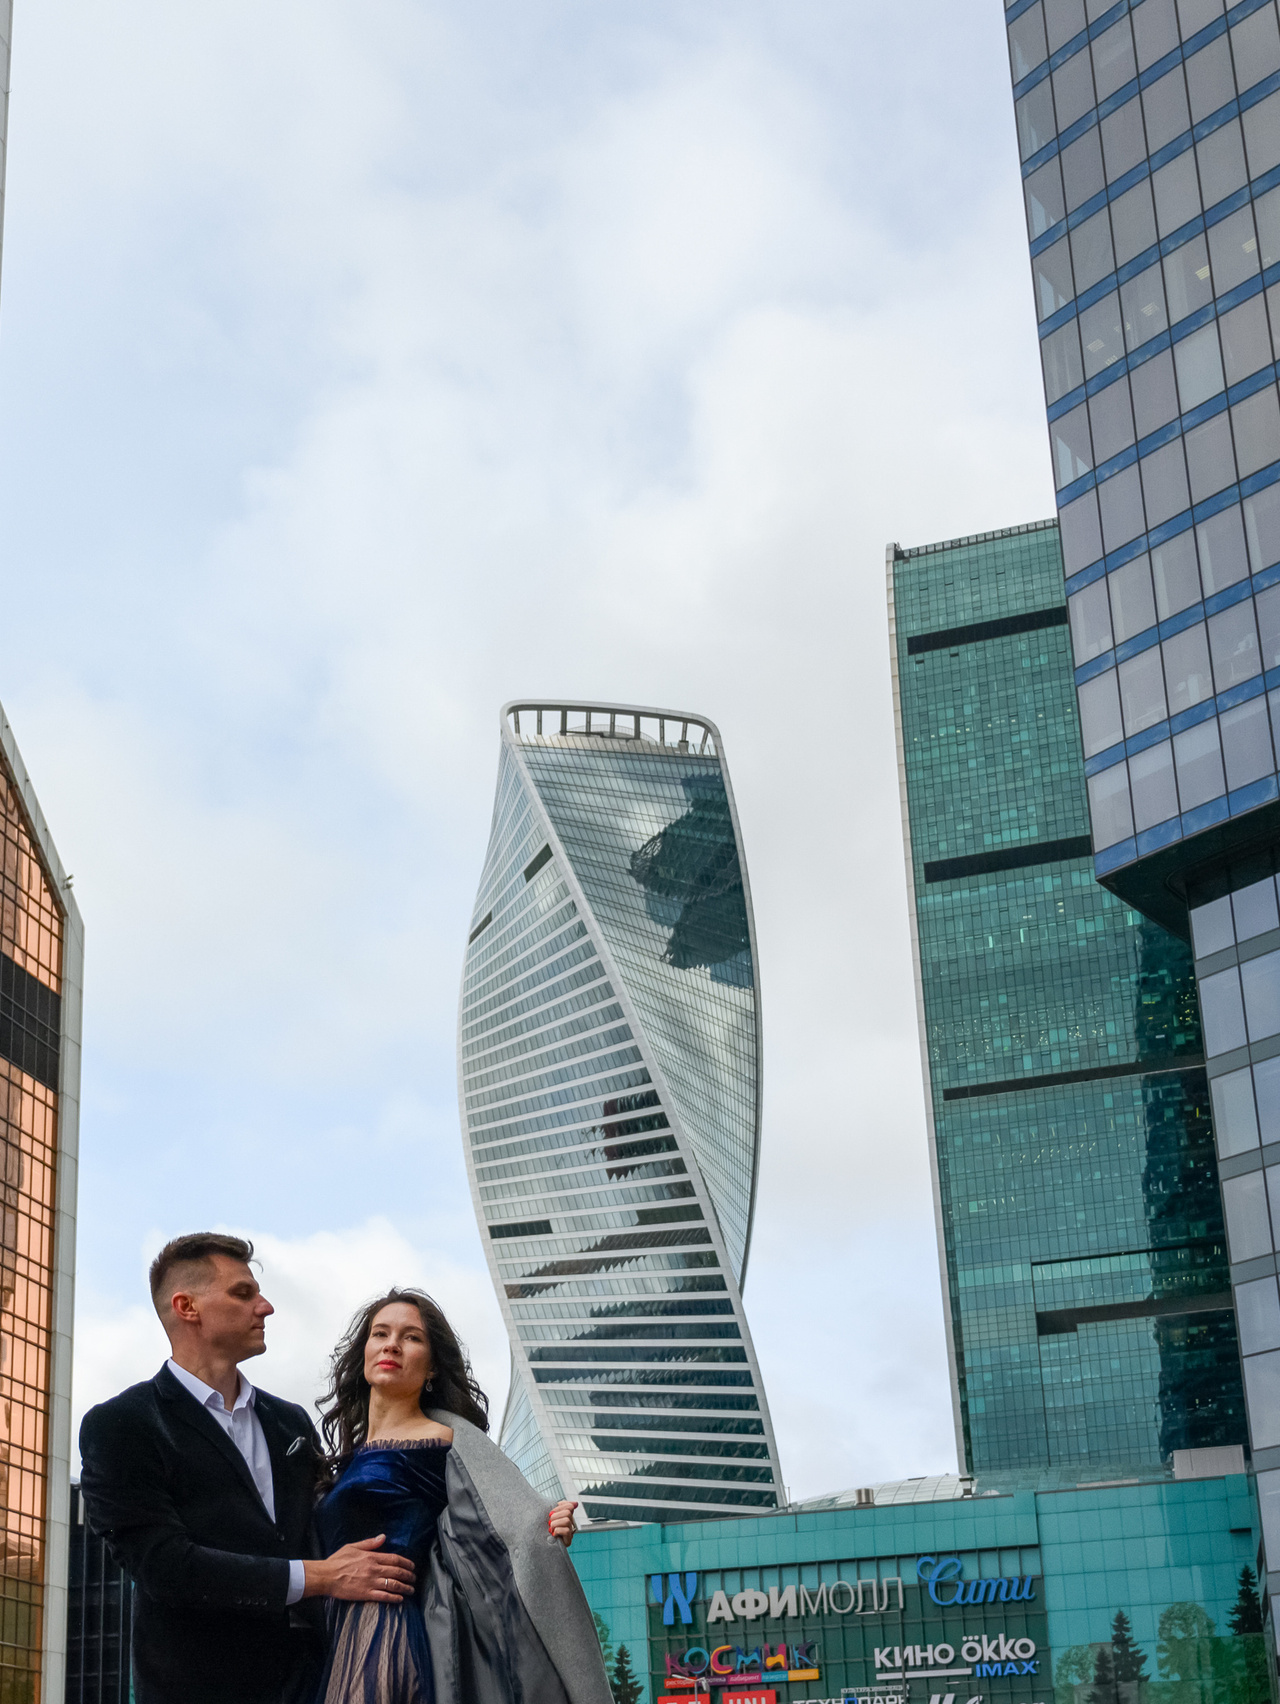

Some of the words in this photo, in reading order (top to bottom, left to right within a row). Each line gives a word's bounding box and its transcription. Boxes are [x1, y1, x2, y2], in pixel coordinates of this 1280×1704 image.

[707, 1576, 904, 1623] АФИМОЛЛ
[874, 1643, 955, 1668] КИНО
[975, 1660, 1037, 1678] IMAX
